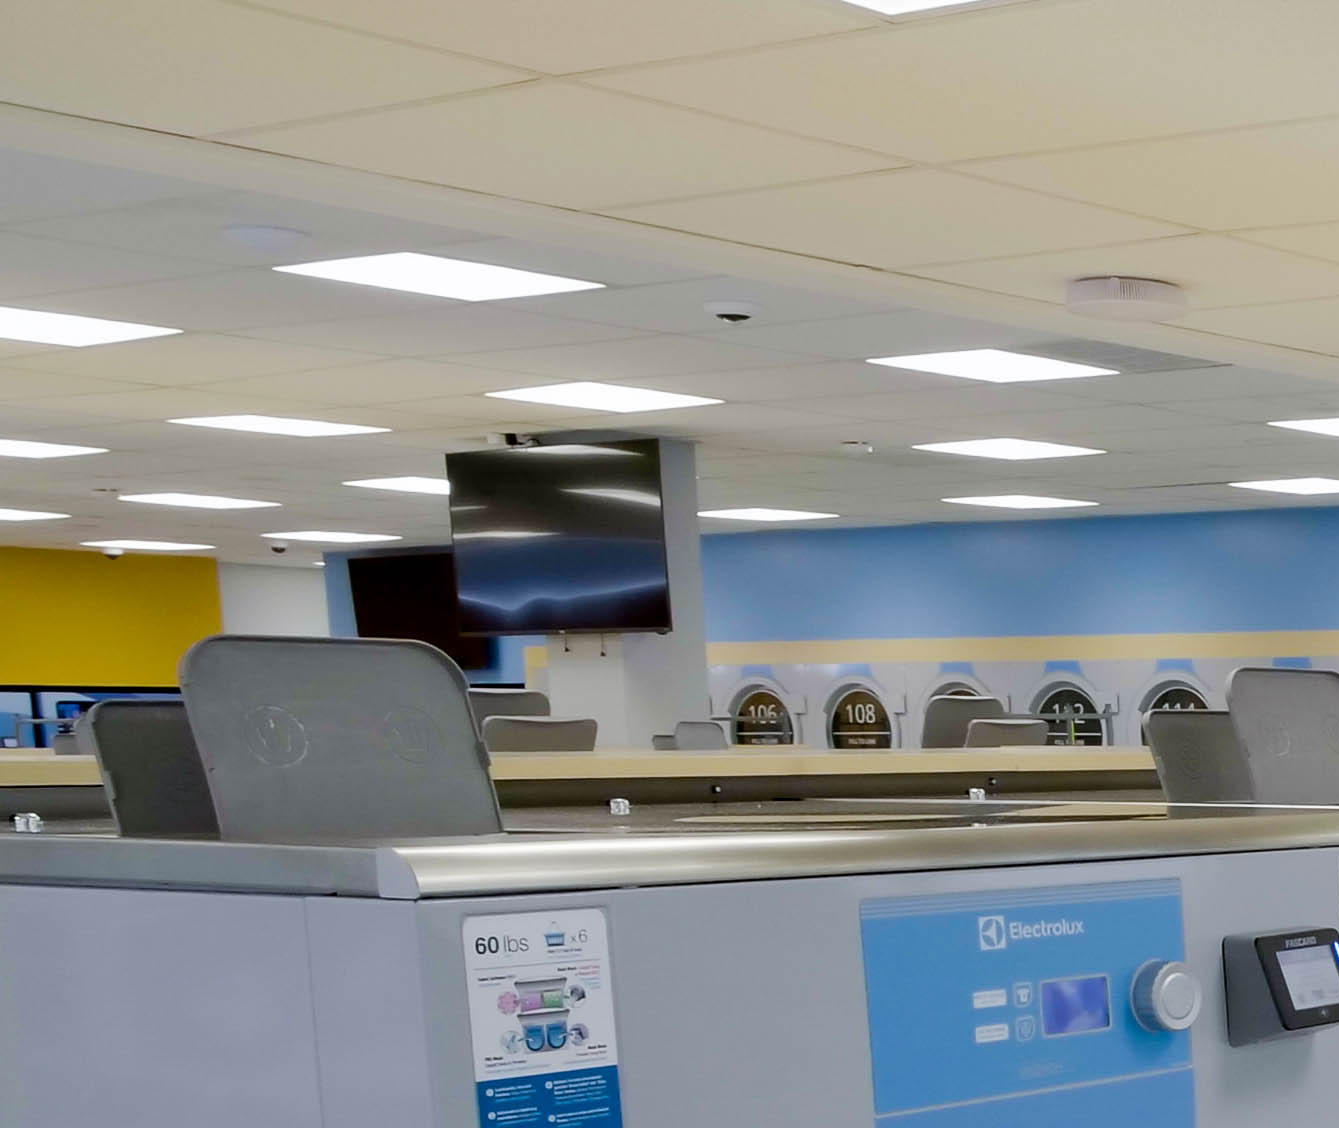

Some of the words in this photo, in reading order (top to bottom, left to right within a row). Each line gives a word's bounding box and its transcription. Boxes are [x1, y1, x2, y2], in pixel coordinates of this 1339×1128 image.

[749, 704, 777, 724] 106
[845, 703, 876, 724] 108
[1053, 703, 1085, 724] 12
[1009, 919, 1085, 940] Electrolux
[475, 936, 499, 955] 60
[503, 935, 530, 953] lbs
